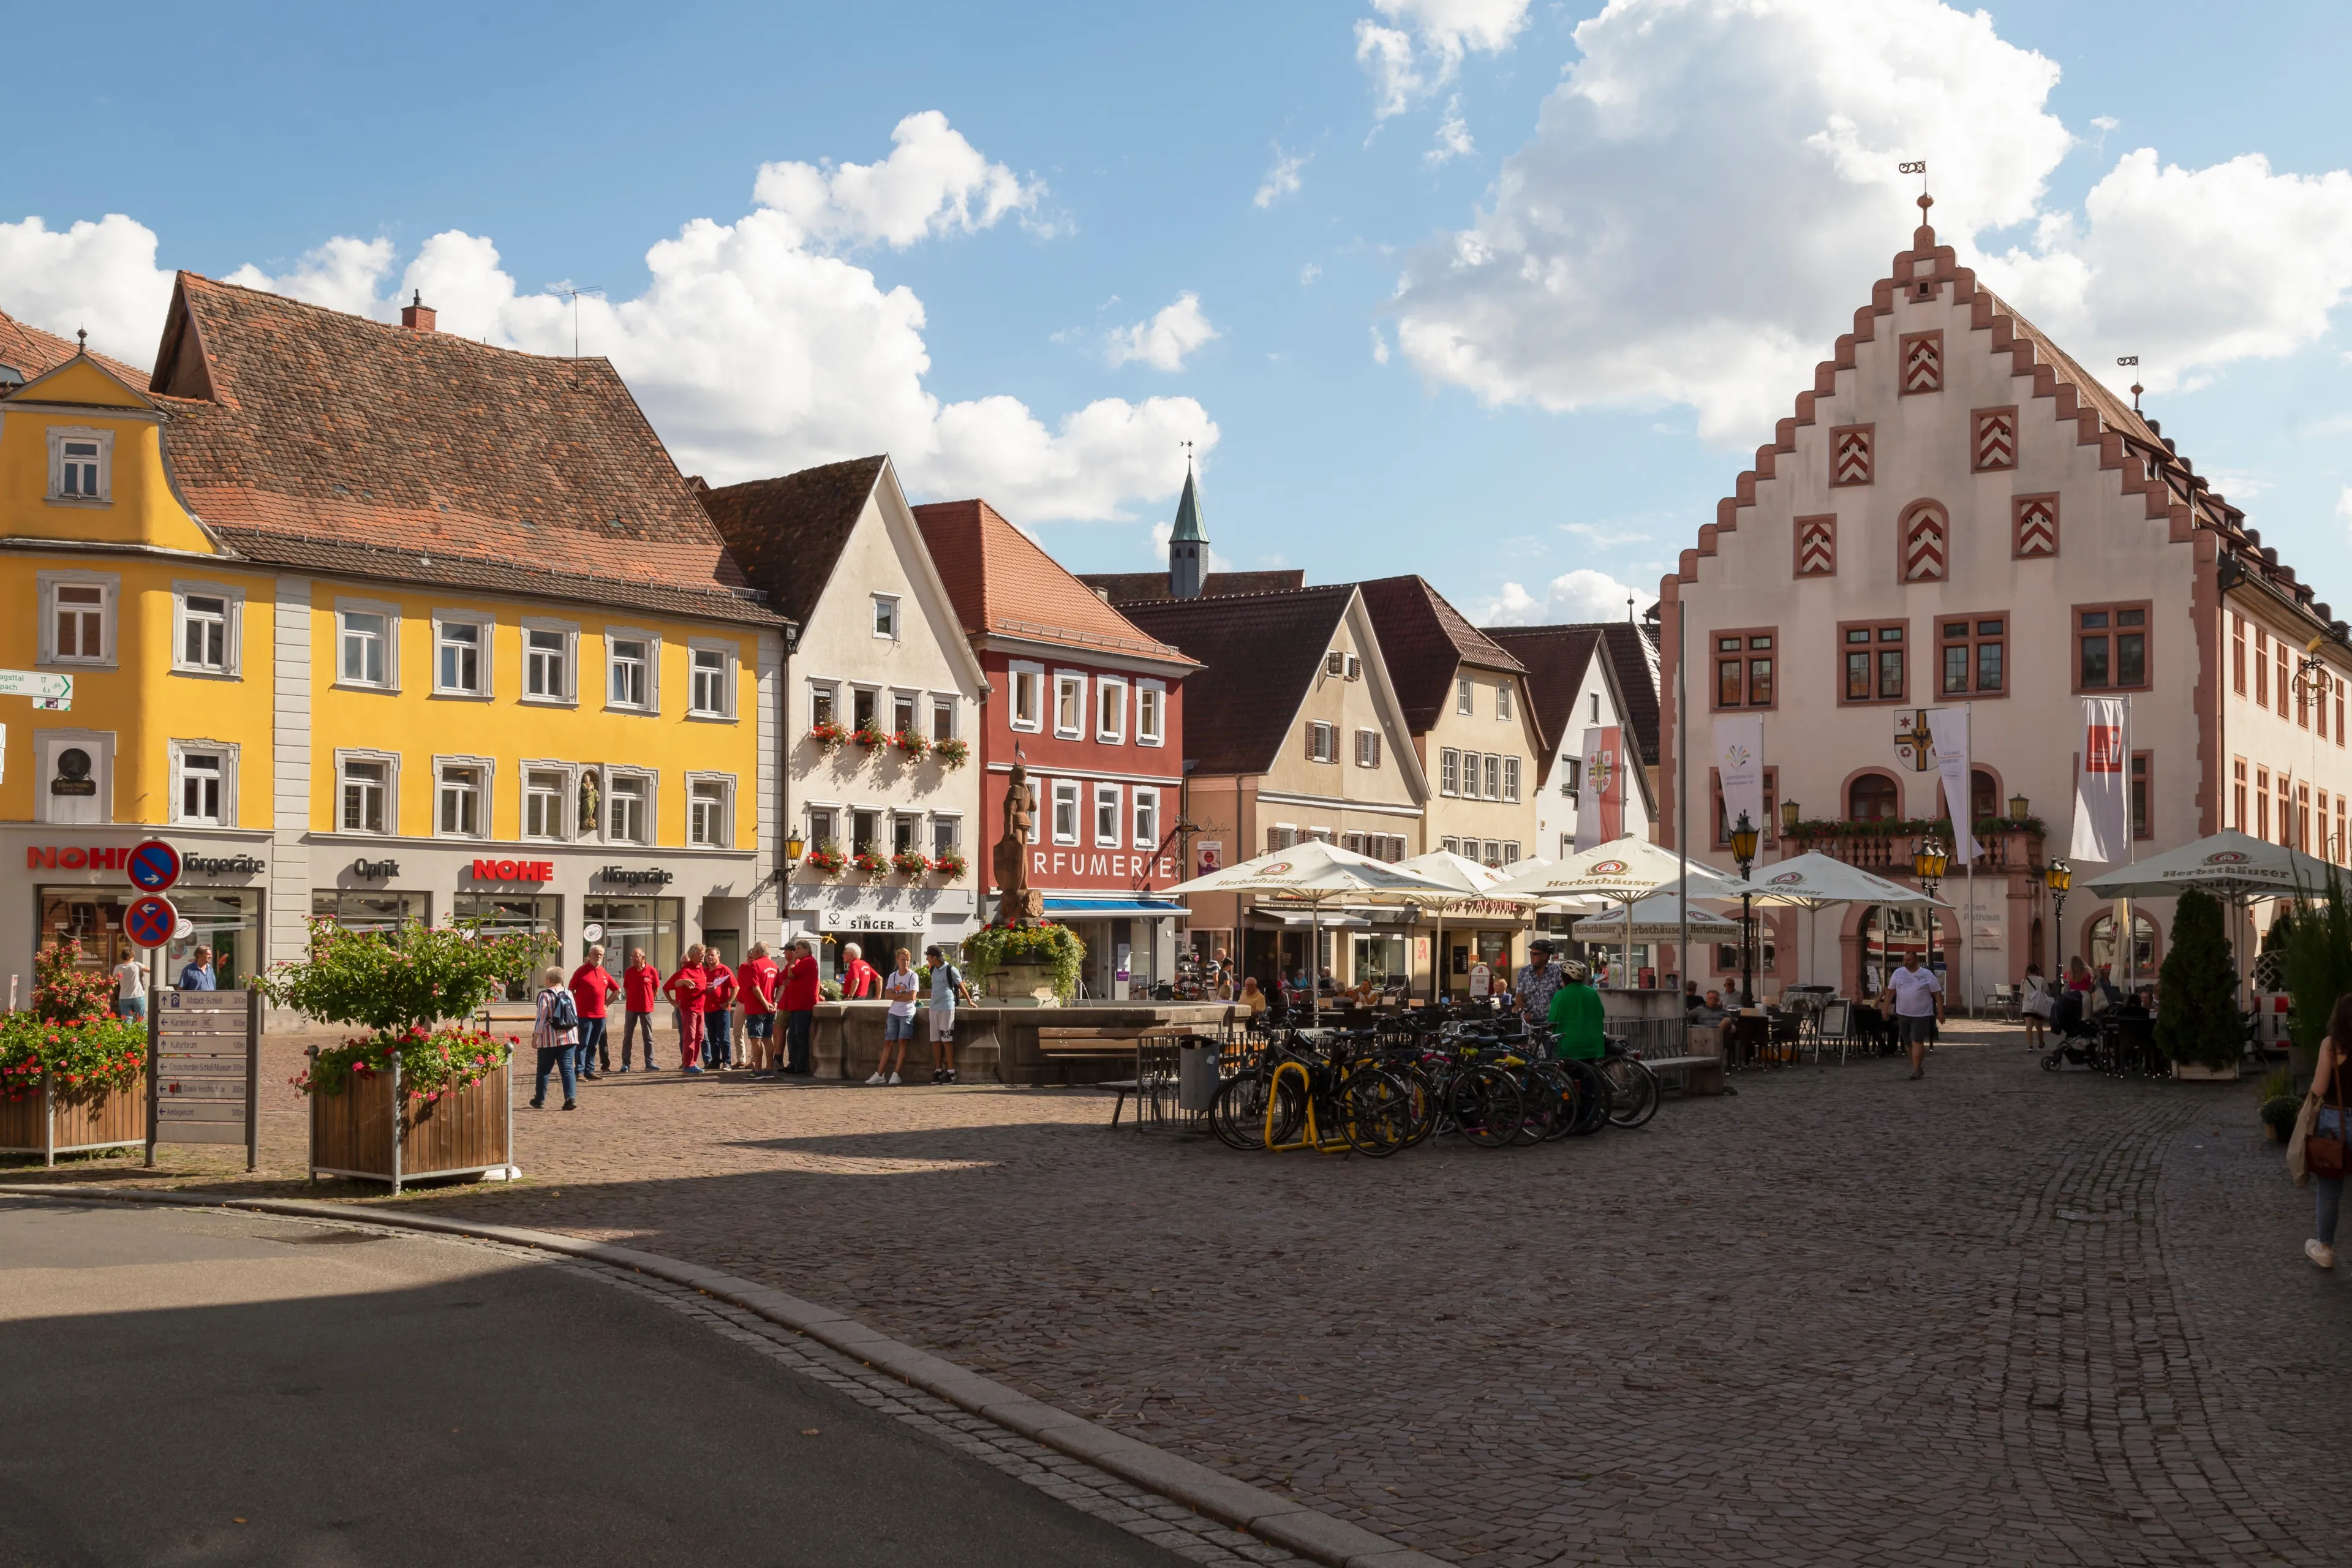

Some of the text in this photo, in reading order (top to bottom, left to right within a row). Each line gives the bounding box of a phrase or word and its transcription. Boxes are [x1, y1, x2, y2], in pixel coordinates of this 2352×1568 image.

[354, 858, 400, 881] Optik
[473, 859, 553, 881] NOHE
[1034, 852, 1171, 878] RFUMERIE
[603, 865, 673, 888] Hörgeräte
[2162, 865, 2290, 878] Herbsthäuser
[1215, 876, 1307, 886] Herbsthäuser
[1545, 877, 1659, 888] Herbsthäuser
[1770, 886, 1824, 896] thäuser
[1476, 900, 1518, 911] APOTHE
[850, 920, 894, 930] SINGER
[1574, 924, 1616, 933] Herbsthäuser
[1622, 924, 1680, 934] Herbsthäuse
[1690, 924, 1737, 935] Herbsthäuser
[167, 1108, 245, 1117] Amtsgericht 300m
